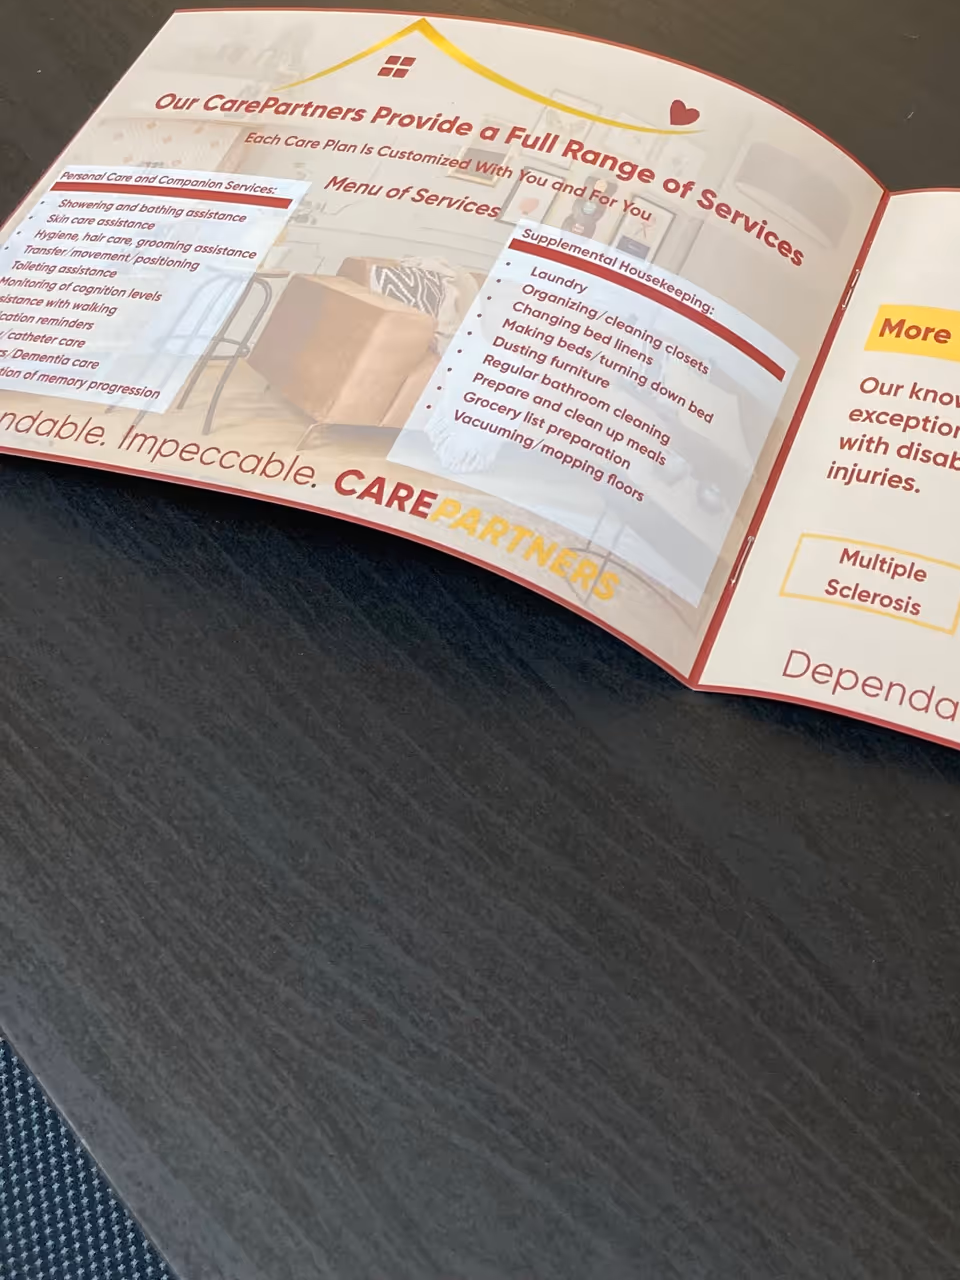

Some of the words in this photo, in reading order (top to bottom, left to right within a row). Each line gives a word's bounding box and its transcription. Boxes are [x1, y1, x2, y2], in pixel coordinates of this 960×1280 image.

[60, 172, 105, 180] Personal
[107, 173, 132, 182] Care
[135, 174, 156, 183] and
[159, 177, 222, 190] Companion
[224, 181, 278, 195] Services:
[155, 93, 200, 111] Our
[204, 94, 367, 122] CarePartners
[370, 106, 474, 136] Provide
[480, 124, 500, 141] a
[504, 126, 560, 153] Full
[562, 139, 656, 183] Range
[662, 178, 695, 198] of
[697, 189, 805, 266] Services
[245, 132, 281, 146] Each
[284, 135, 320, 149] Care
[322, 139, 356, 154] Plan
[360, 143, 374, 155] Is
[377, 146, 472, 170] Customized
[475, 159, 513, 179] With
[520, 169, 548, 188] You
[552, 179, 584, 197] and
[588, 189, 618, 207] For
[623, 202, 652, 221] You
[58, 199, 114, 212] Showering
[116, 203, 138, 212] and
[140, 201, 183, 217] bathing
[186, 208, 247, 222] assistance
[324, 176, 382, 197] Menu
[386, 187, 410, 200] of
[411, 187, 502, 219] Services
[47, 214, 69, 223] Skin
[71, 217, 95, 225] care
[97, 218, 155, 230] assistance
[23, 245, 200, 272] Transfer/movement/positioning
[34, 229, 80, 241] Hygiene,
[82, 233, 105, 242] hair
[107, 236, 133, 246] care,
[136, 236, 192, 252] grooming
[194, 243, 257, 260] assistance
[11, 261, 57, 274] Toileting
[58, 266, 117, 278] assistance
[521, 228, 618, 267] Supplemental
[619, 262, 715, 316] Housekeeping:
[530, 266, 588, 294] Laundry
[0, 277, 57, 291] Monitoring
[59, 282, 73, 291] of
[72, 284, 126, 297] cognition
[128, 289, 162, 302] levels
[512, 301, 581, 334] Changing
[583, 326, 612, 346] bed
[614, 338, 654, 366] linens
[522, 284, 662, 350] Organizing/cleaning
[665, 345, 710, 374] closets
[879, 318, 951, 344] More
[492, 336, 547, 364] Dusting
[550, 356, 611, 388] furniture
[502, 319, 555, 344] Making
[557, 338, 648, 387] beds/turning
[651, 381, 686, 407] down
[688, 401, 714, 424] bed
[482, 354, 539, 381] Regular
[541, 374, 611, 412] bathroom
[613, 407, 671, 446] cleaning
[859, 377, 904, 395] Our
[463, 391, 522, 421] Grocery
[524, 411, 545, 428] list
[546, 423, 631, 469] preparation
[472, 372, 529, 399] Prepare
[533, 395, 562, 412] and
[564, 408, 603, 431] clean
[606, 427, 625, 443] up
[627, 438, 667, 465] meals
[454, 410, 604, 481] Vacuuming/mopping
[606, 473, 645, 502] floors
[838, 433, 889, 455] with
[826, 462, 920, 494] injuries.
[118, 425, 316, 488] Impeccable.
[334, 469, 621, 600] CAREPARTNERS
[840, 548, 928, 582] Multiple
[824, 579, 921, 616] Sclerosis
